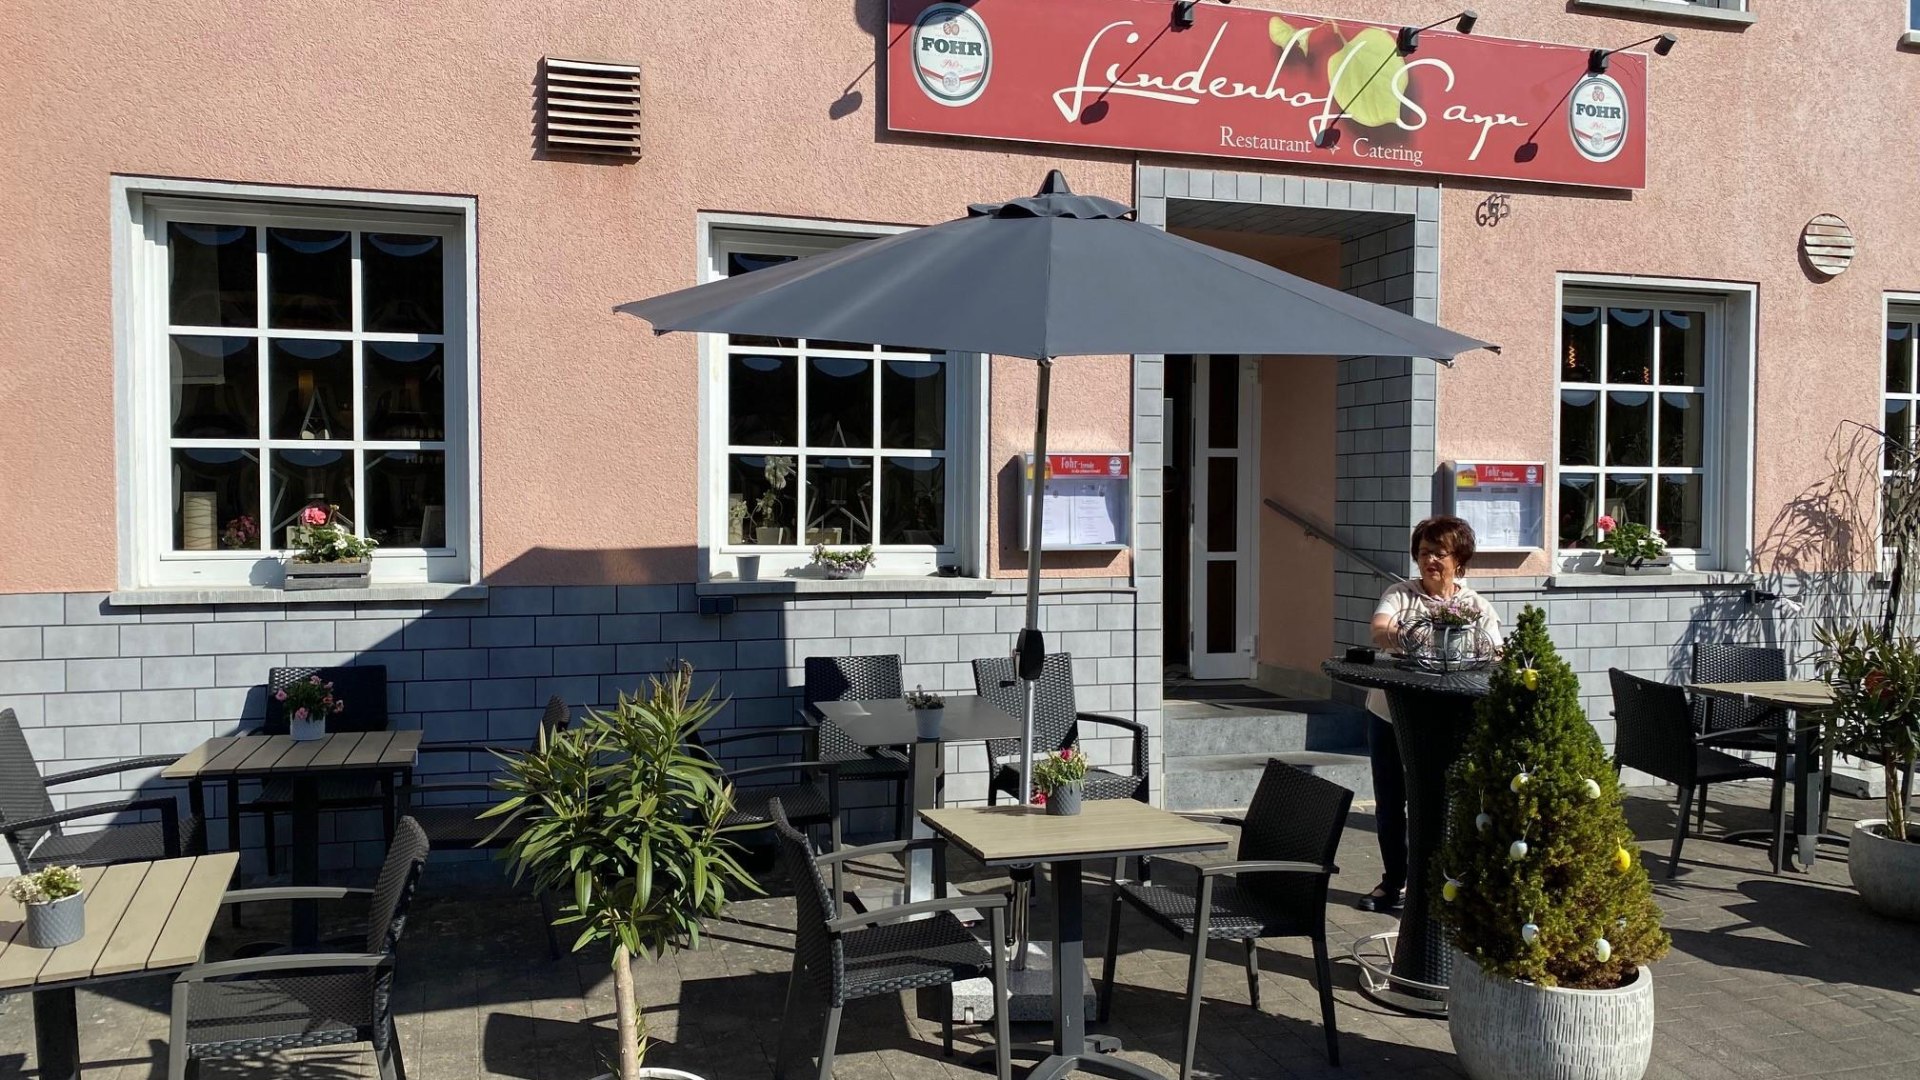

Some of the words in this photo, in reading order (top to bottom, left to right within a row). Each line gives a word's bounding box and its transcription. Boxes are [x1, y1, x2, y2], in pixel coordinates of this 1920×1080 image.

[921, 37, 982, 56] FOHR
[1053, 20, 1367, 147] Lindenhof
[1391, 57, 1528, 161] Sayn
[1576, 103, 1621, 119] FOHR
[1219, 125, 1312, 153] Restaurant
[1353, 137, 1423, 167] Catering
